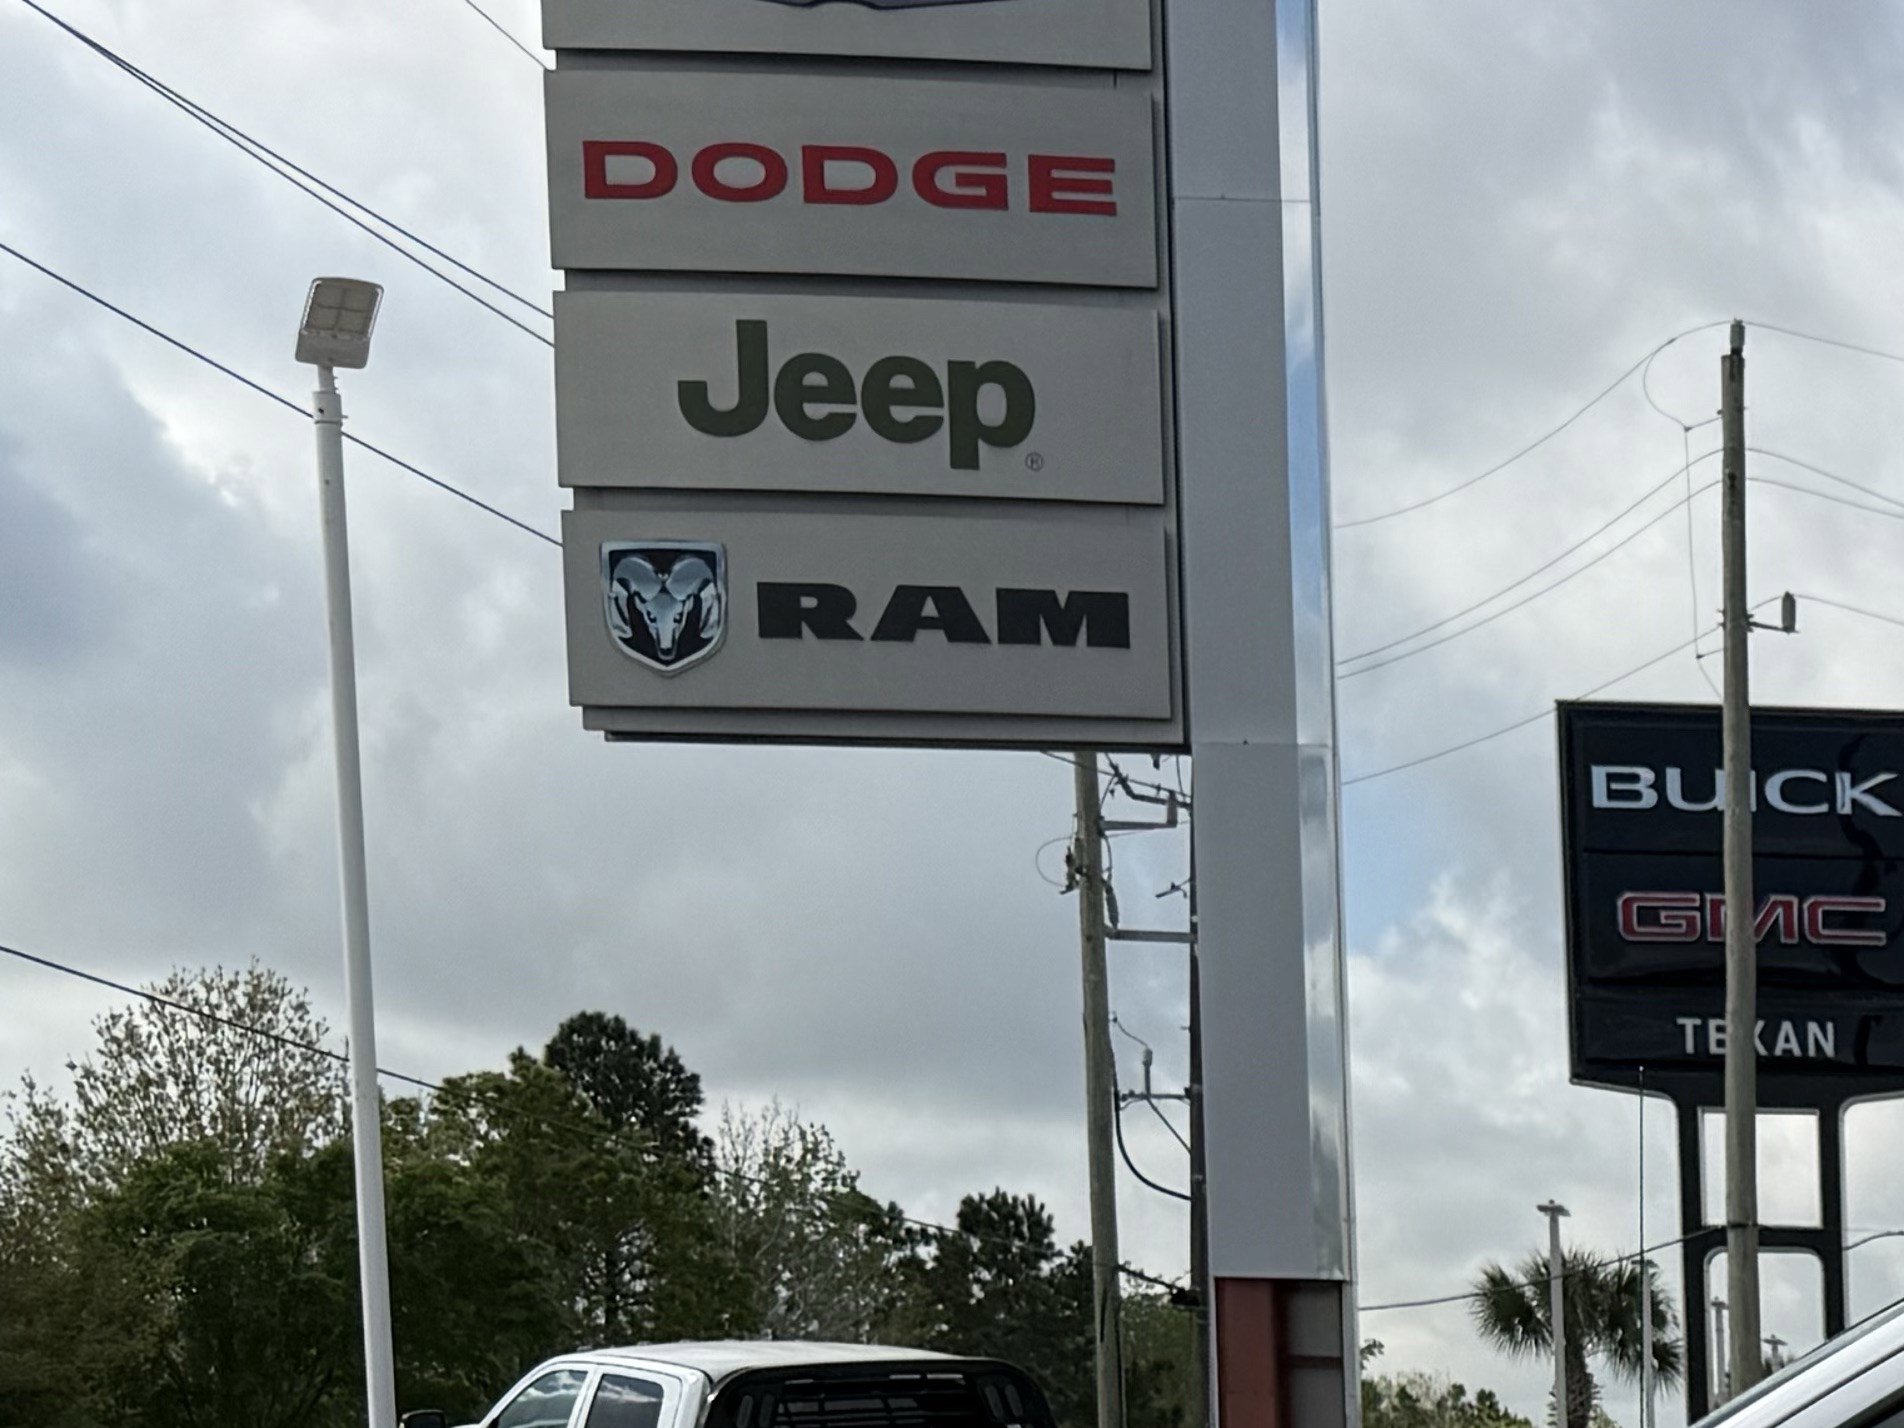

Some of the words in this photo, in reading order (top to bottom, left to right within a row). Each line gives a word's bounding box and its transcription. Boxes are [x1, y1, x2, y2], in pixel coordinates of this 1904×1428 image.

[582, 140, 1118, 218] DODGE
[677, 319, 1036, 470] Jeep
[756, 582, 1131, 649] RAM
[1617, 891, 1888, 946] GMC
